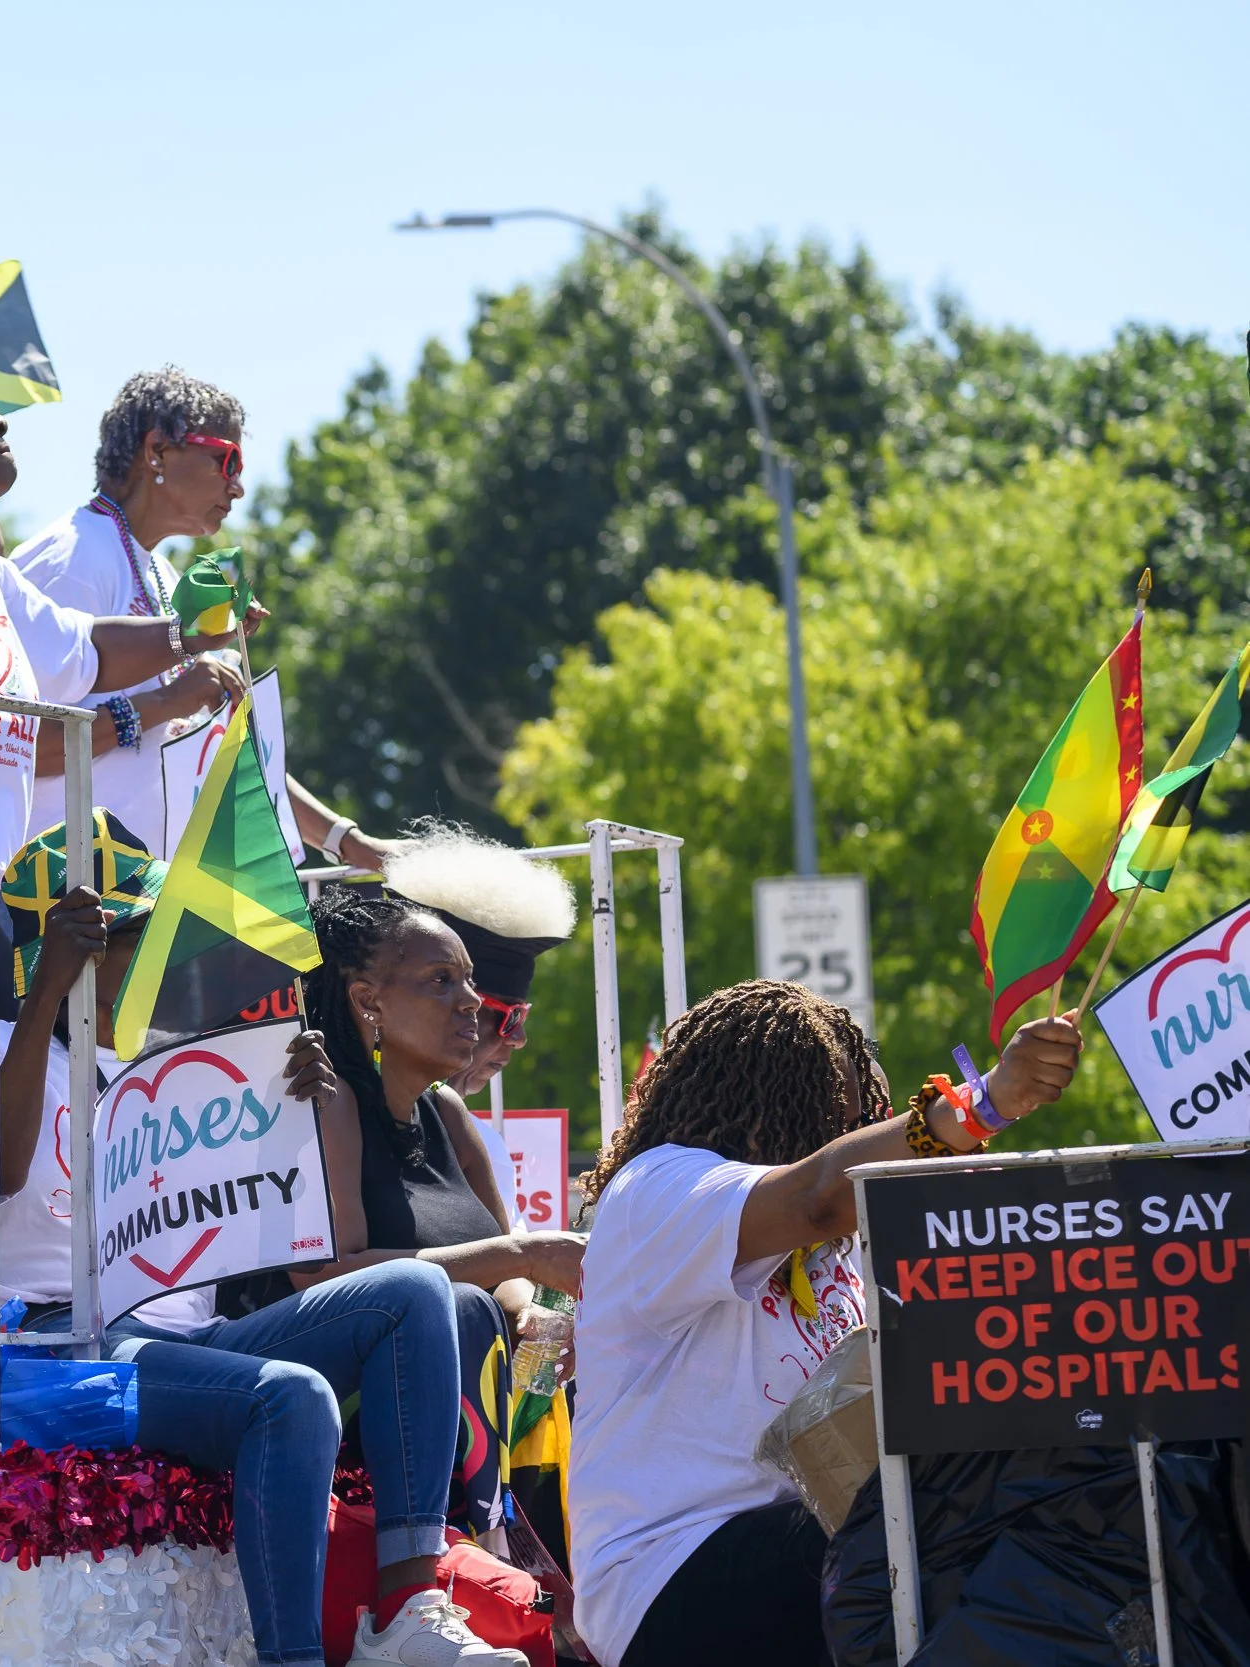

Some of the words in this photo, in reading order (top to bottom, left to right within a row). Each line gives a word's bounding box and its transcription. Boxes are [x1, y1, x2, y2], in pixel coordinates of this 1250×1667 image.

[7, 712, 34, 744] ALL
[776, 948, 853, 996] 25
[1170, 1051, 1250, 1129] COM
[103, 1087, 281, 1202] nurses
[100, 1167, 300, 1277] COMMUNITY
[926, 1200, 1122, 1248] NURSES
[1141, 1193, 1231, 1234] SAY
[896, 1253, 1036, 1302] KEEP
[1051, 1246, 1138, 1292] ICE
[975, 1304, 1051, 1349] OF
[1074, 1296, 1201, 1343] OUR
[932, 1345, 1238, 1404] HOSPITALS
